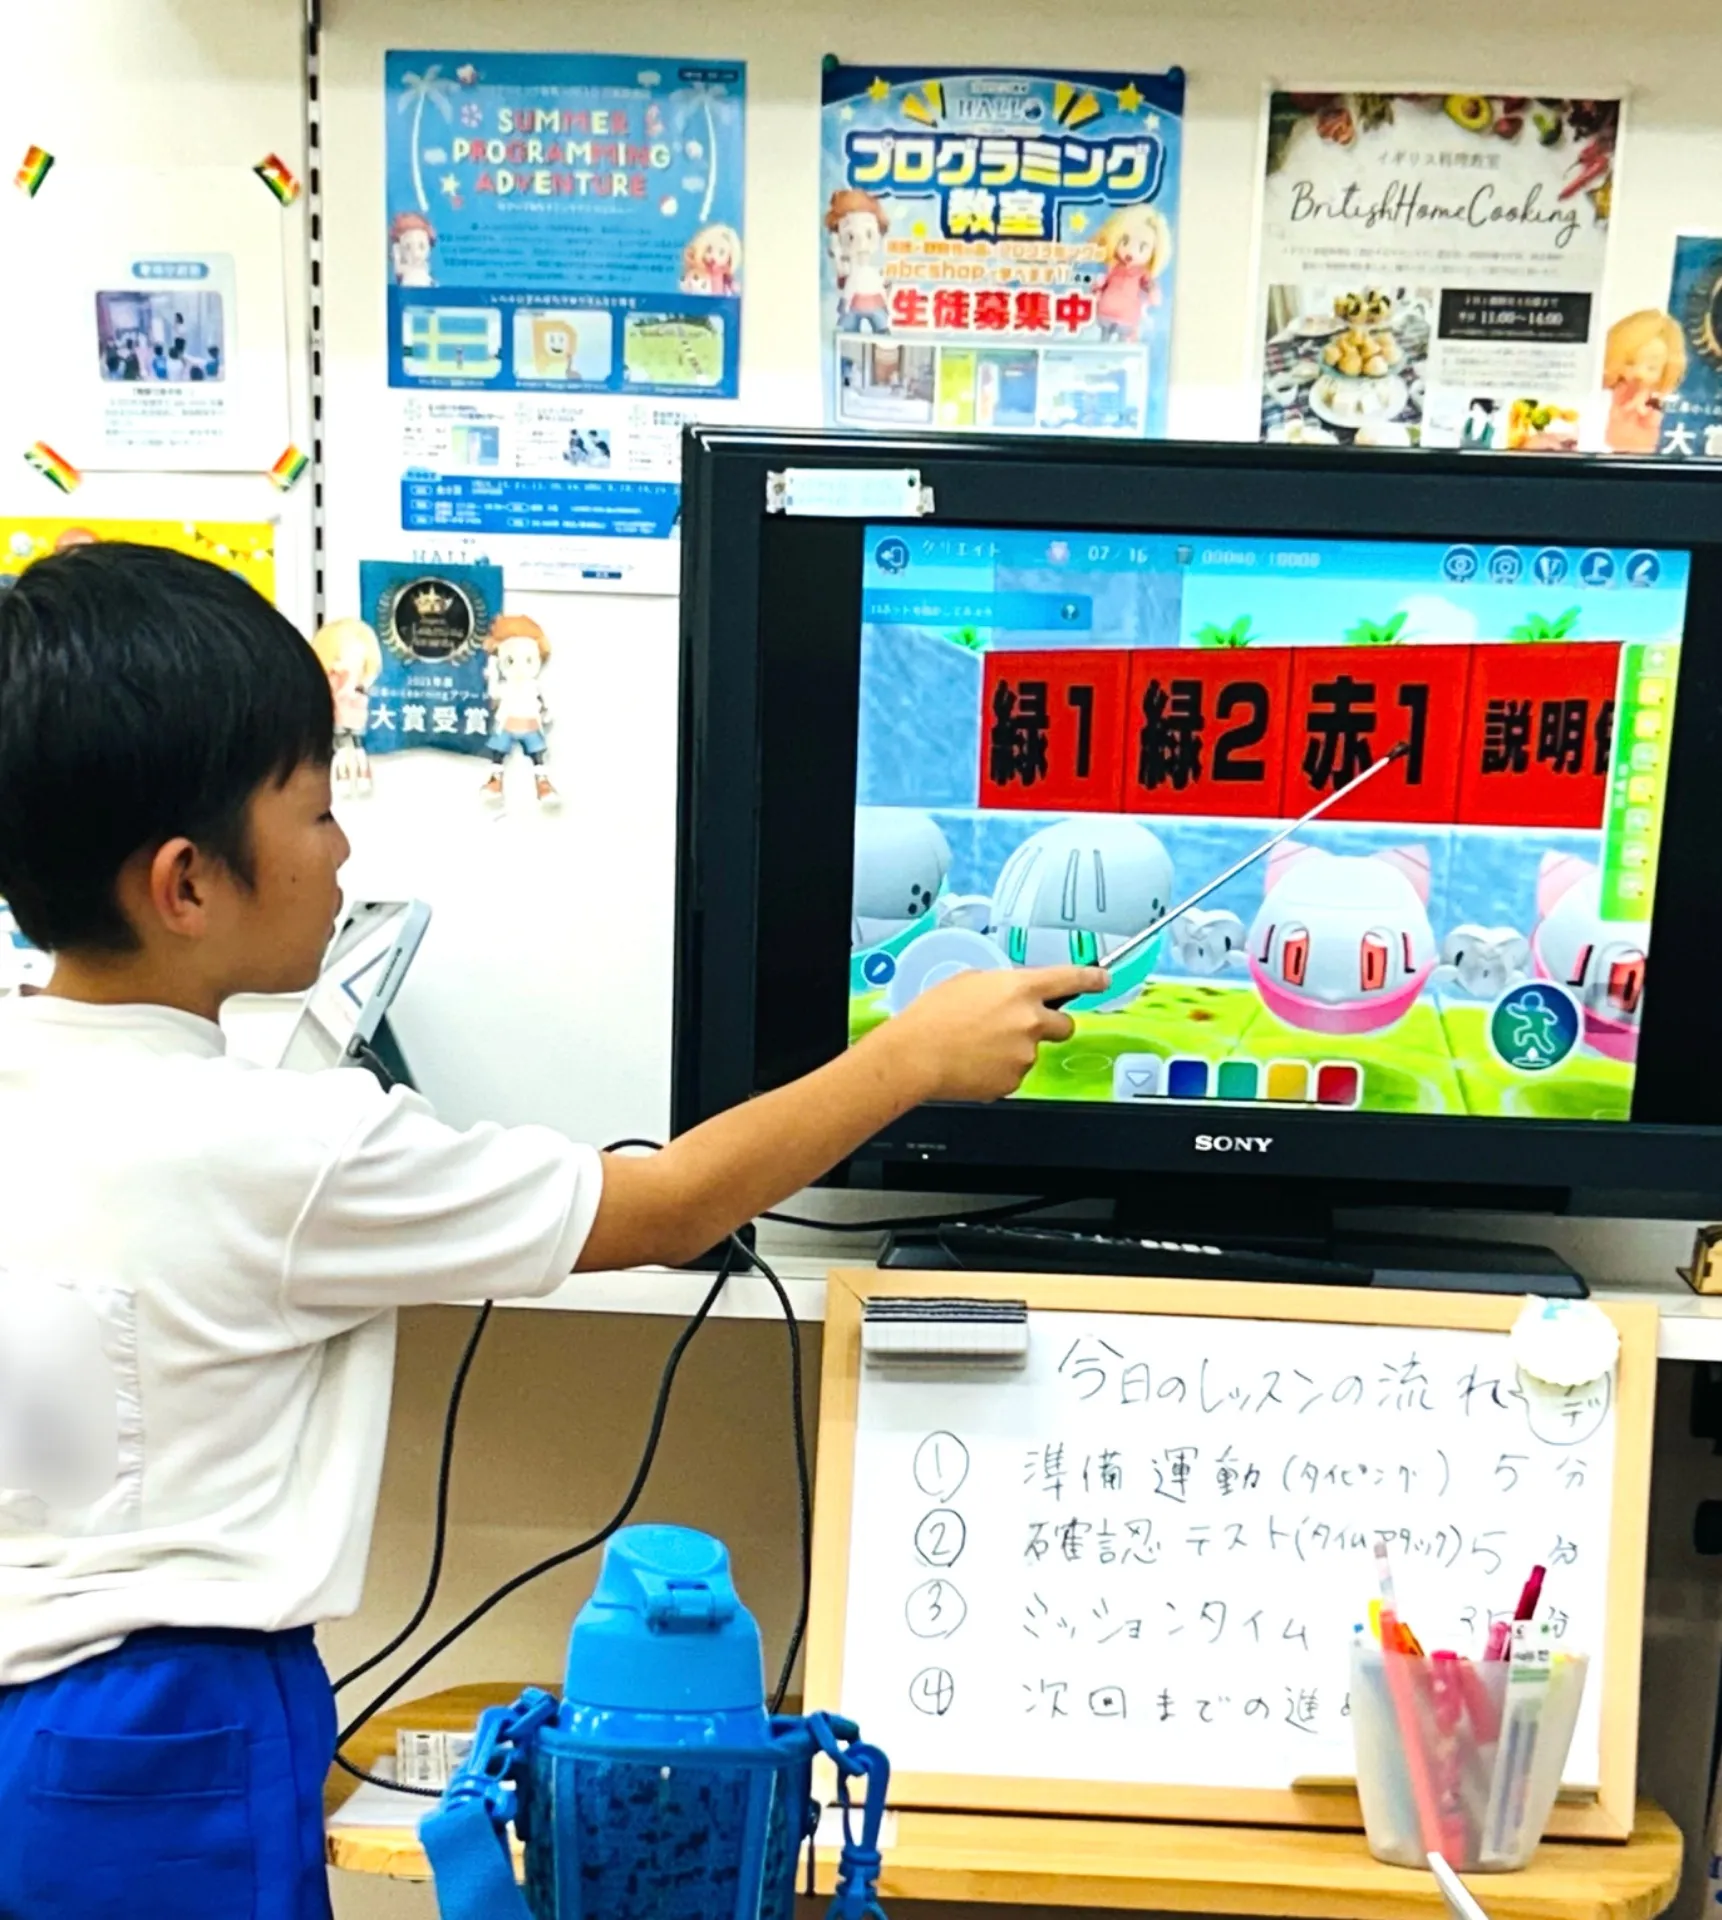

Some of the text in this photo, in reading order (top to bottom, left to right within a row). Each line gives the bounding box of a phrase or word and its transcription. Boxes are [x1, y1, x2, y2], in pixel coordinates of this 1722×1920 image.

[498, 107, 629, 134] SUMMER
[453, 138, 671, 169] PROGRAMMING
[851, 137, 1150, 190] プログラミング
[475, 171, 648, 198] ADVENTURE
[947, 188, 1046, 237] 教室
[891, 288, 1093, 333] 生徒募集中
[1088, 545, 1110, 562] 07
[371, 703, 489, 736] 大賞受賞
[990, 679, 1094, 787] 緑1
[1138, 679, 1271, 791] 緑2
[1302, 675, 1430, 791] 赤1
[1195, 1135, 1274, 1153] SONY
[1057, 1338, 1509, 1417] 今日のレッスンの流れ
[1023, 1592, 1310, 1652] ミッションタイム
